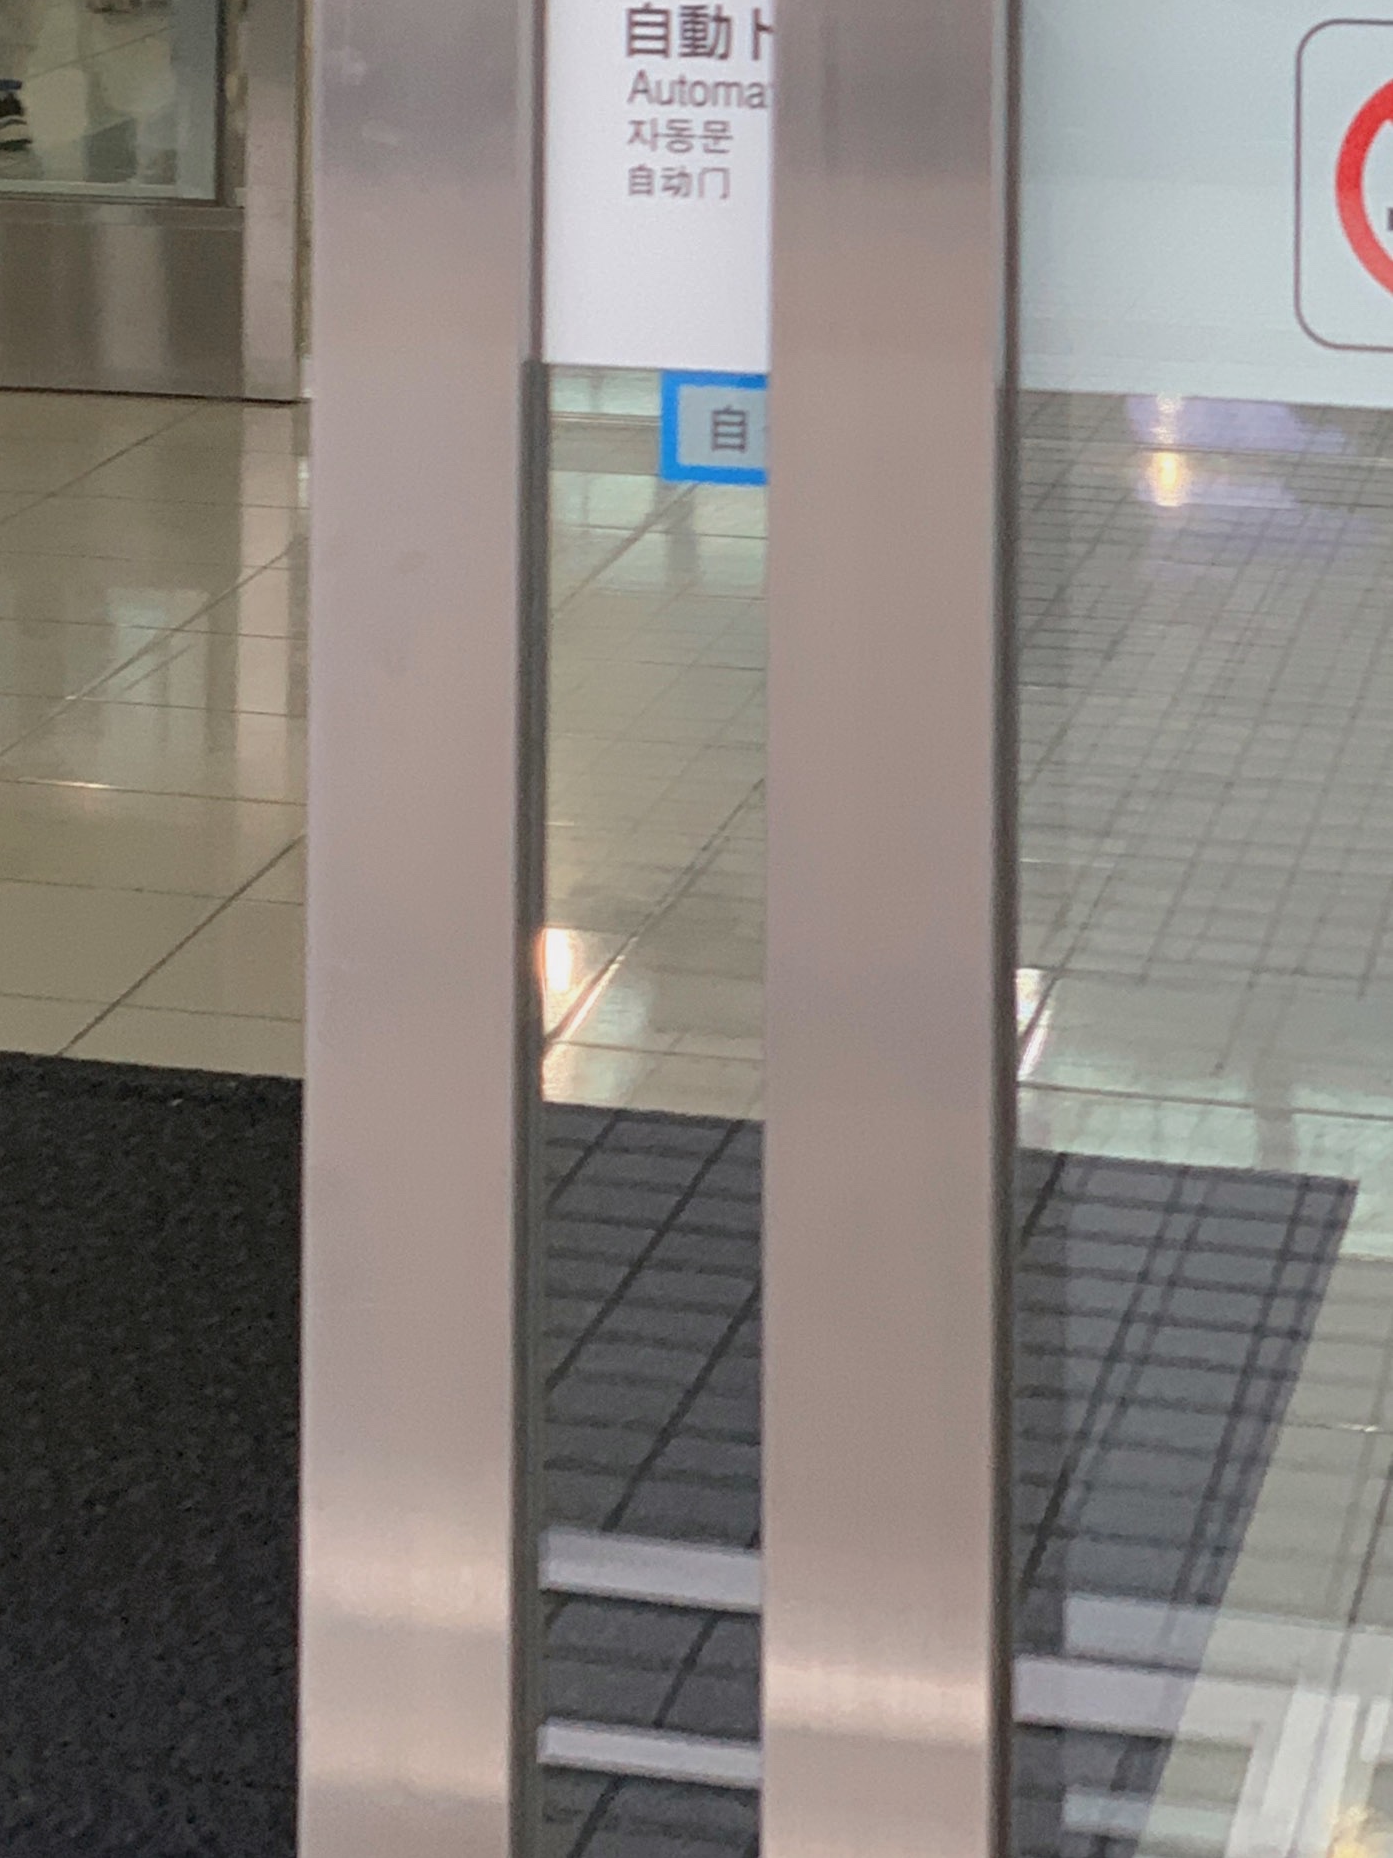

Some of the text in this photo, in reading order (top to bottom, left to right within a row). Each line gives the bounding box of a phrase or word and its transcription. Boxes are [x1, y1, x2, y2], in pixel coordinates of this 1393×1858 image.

[627, 68, 770, 109] Automa
[626, 117, 735, 154] 자동문
[627, 163, 731, 200] 自动门
[710, 403, 748, 453] 自
